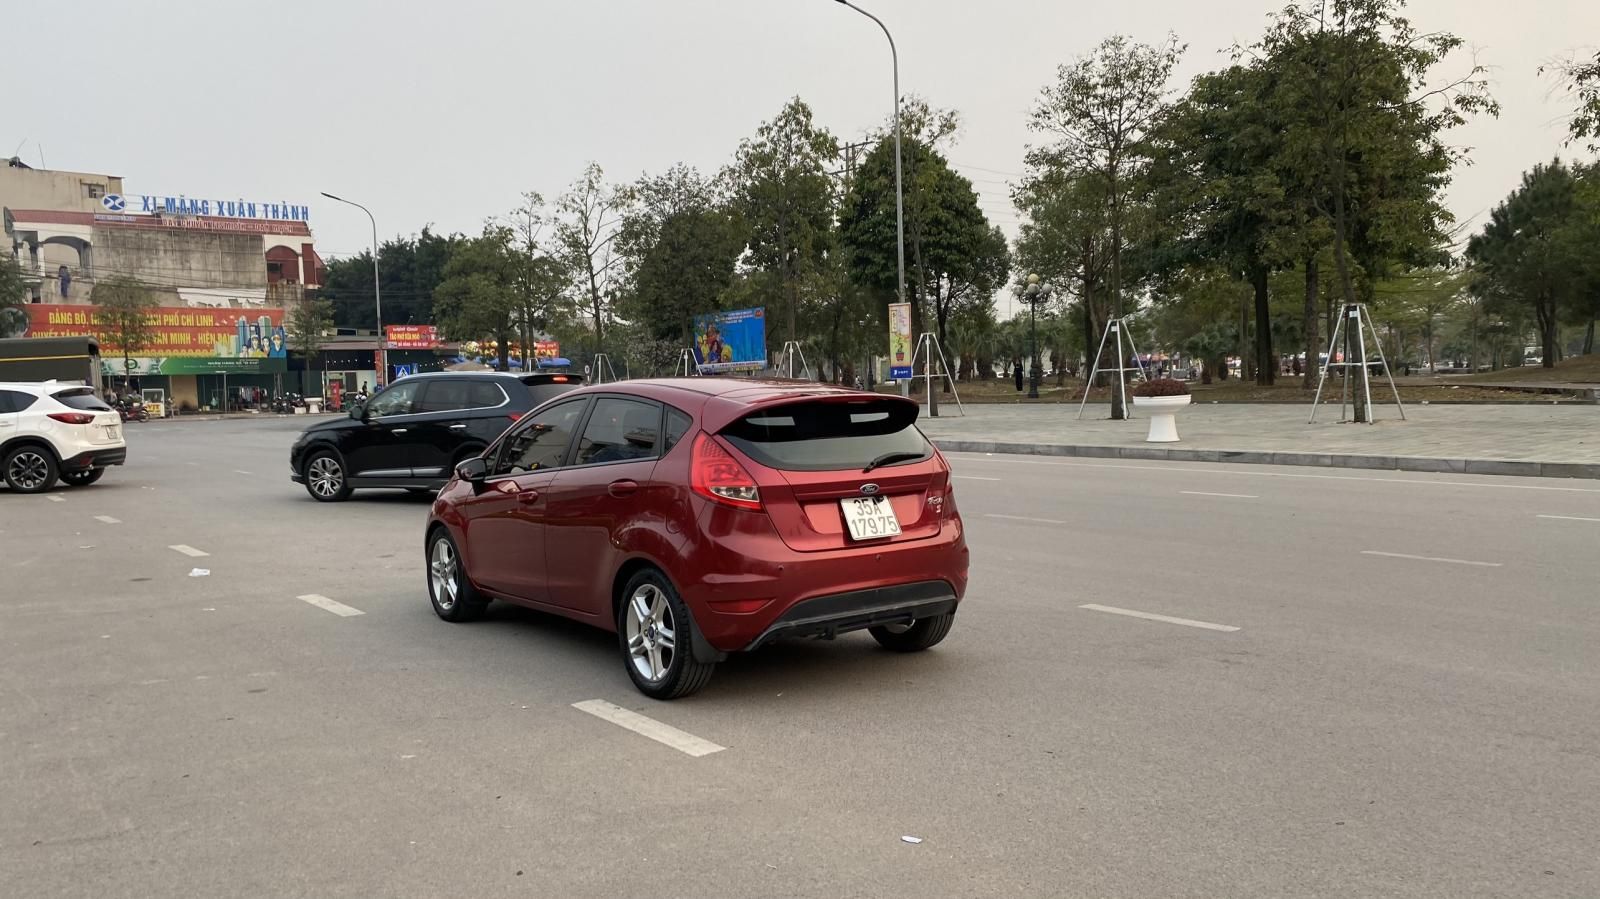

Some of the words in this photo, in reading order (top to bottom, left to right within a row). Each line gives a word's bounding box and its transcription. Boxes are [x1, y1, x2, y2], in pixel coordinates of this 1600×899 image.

[142, 195, 157, 212] XI
[165, 194, 209, 215] MĂNG
[217, 198, 257, 218] XUÂN
[263, 200, 309, 221] THÀNH
[48, 308, 73, 325] ĐẢNG
[163, 309, 179, 326] PHỐ
[195, 314, 214, 327] LINH
[169, 332, 191, 345] MINH
[197, 331, 216, 347] HIỆN
[853, 498, 882, 516] 35A
[851, 515, 898, 537] 179.75
